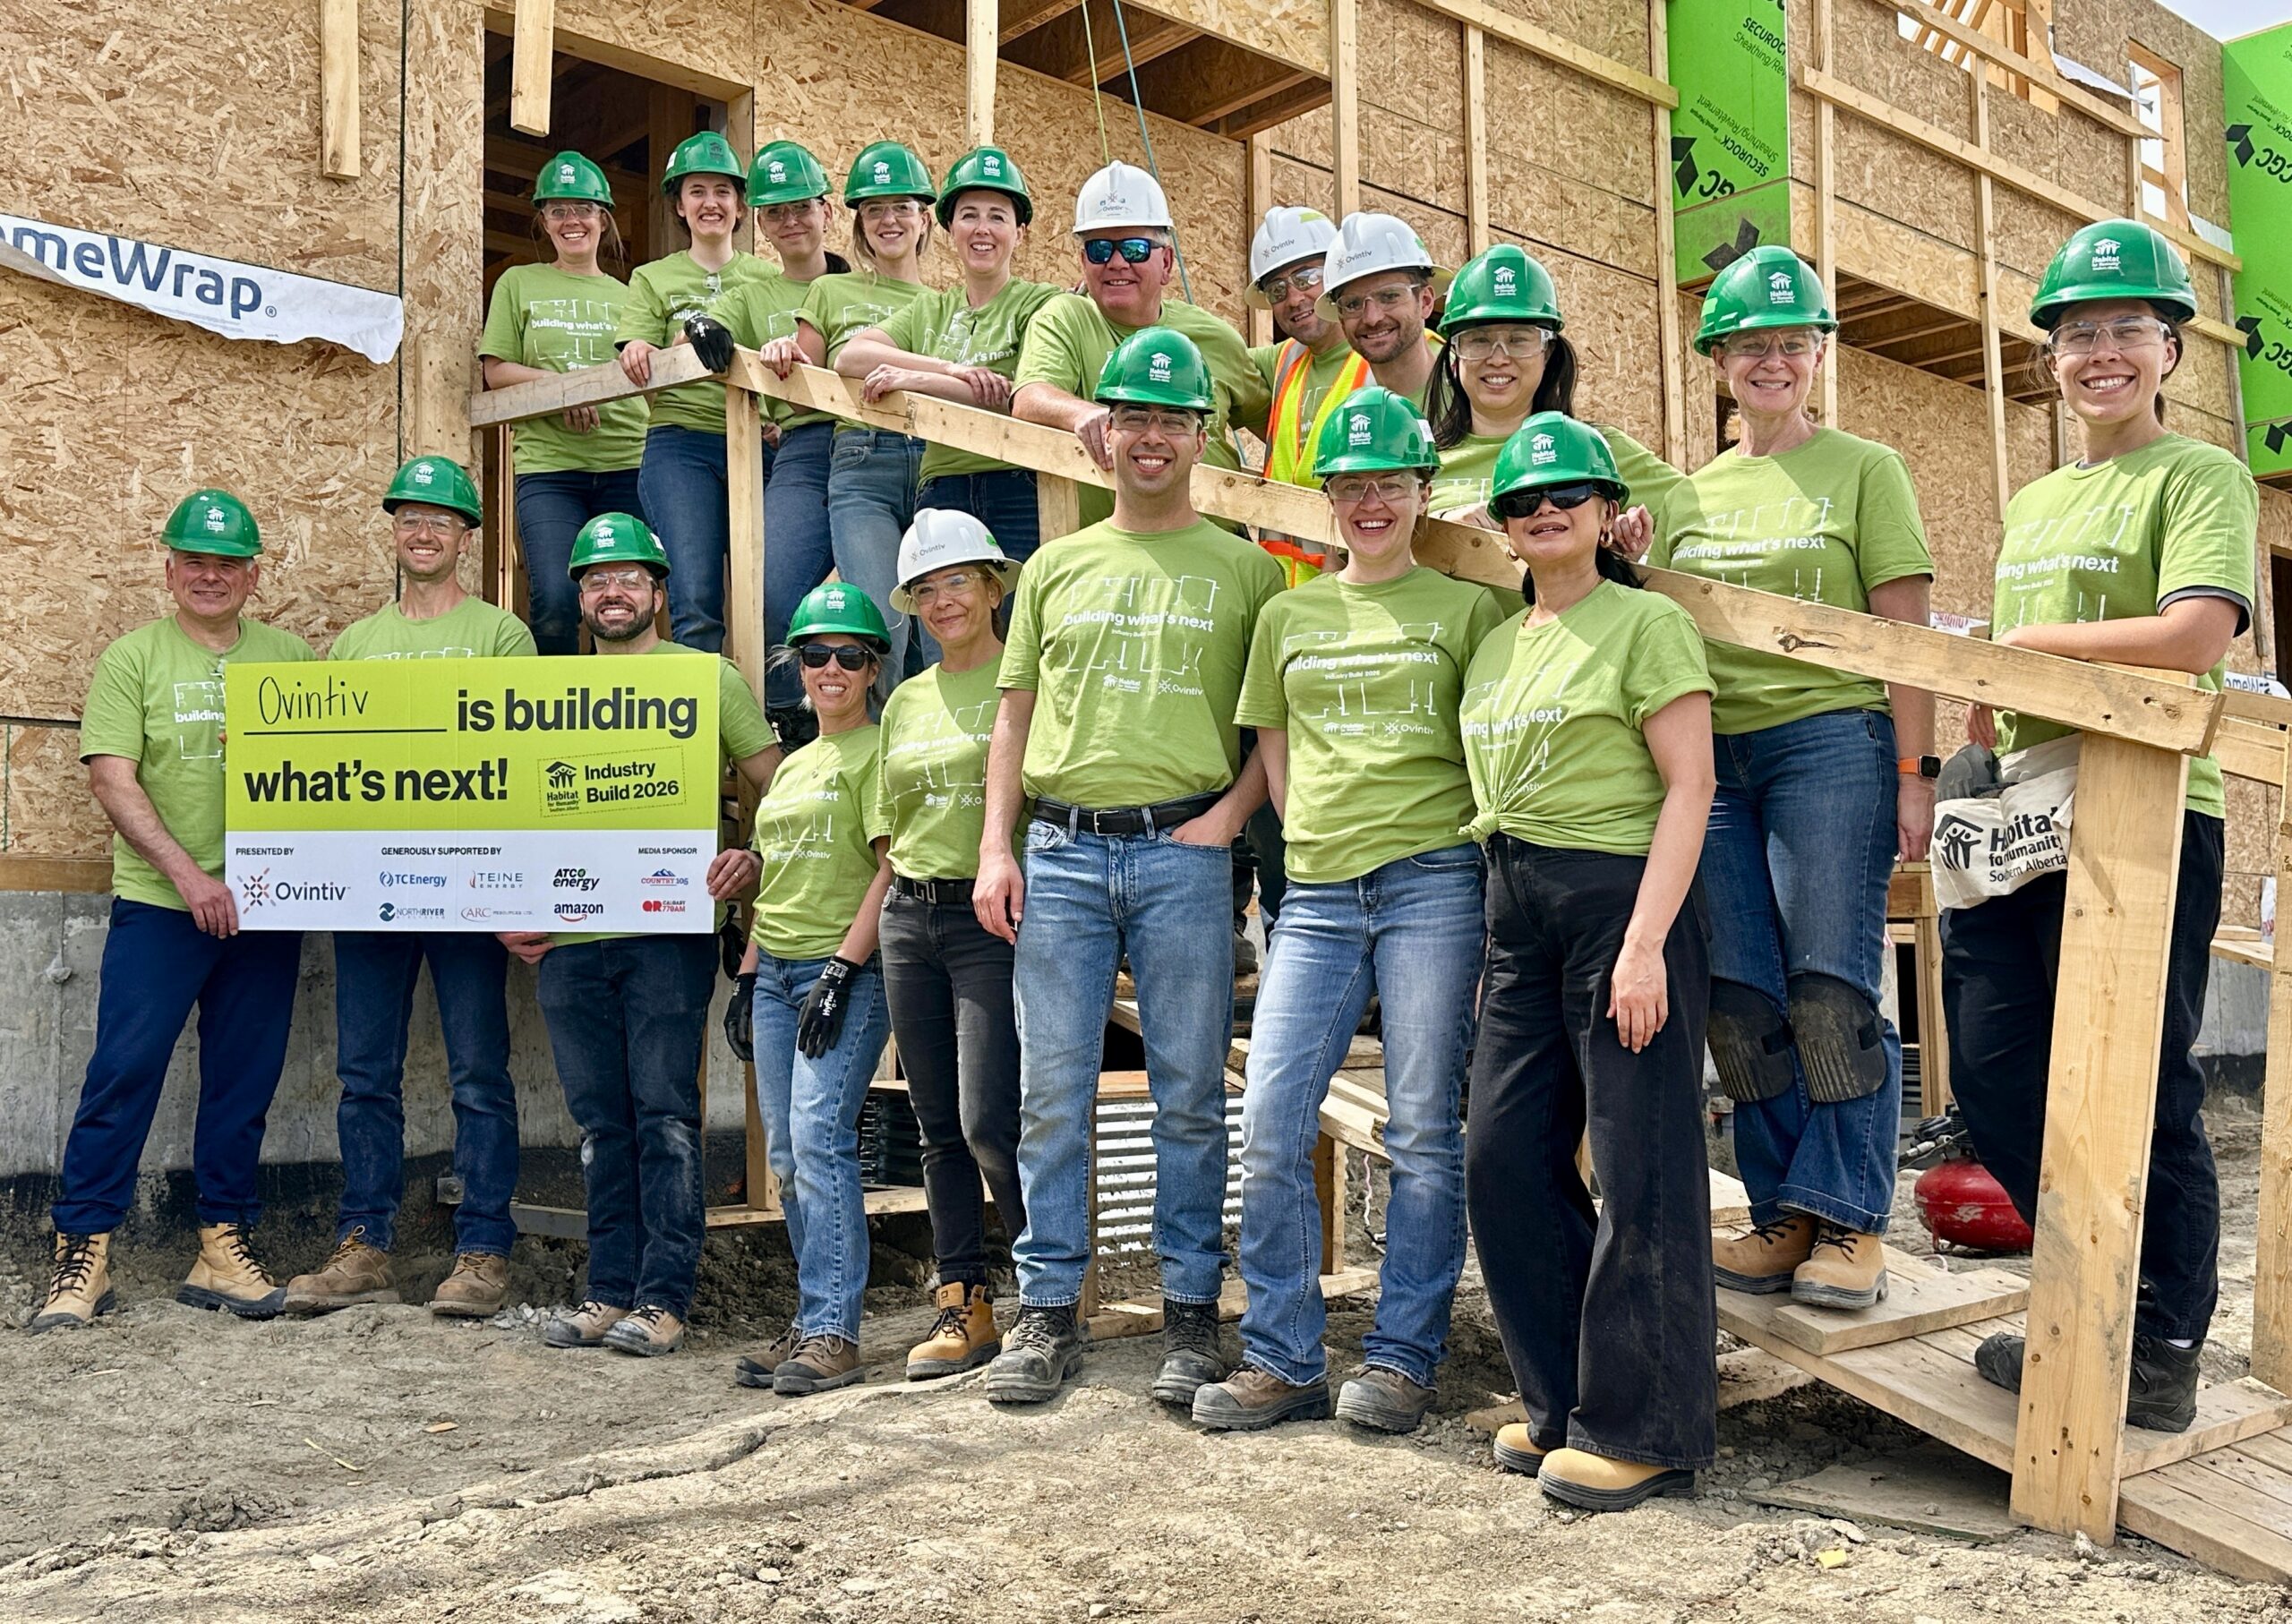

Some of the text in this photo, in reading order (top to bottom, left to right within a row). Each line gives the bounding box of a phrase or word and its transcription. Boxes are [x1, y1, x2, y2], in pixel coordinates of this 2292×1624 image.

[1720, 134, 1769, 177] SECUROCK
[1271, 239, 1295, 253] Ovintiv
[1346, 250, 1373, 263] Ovintiv
[919, 543, 945, 557] Ovintiv
[1725, 537, 1781, 556] what's
[1784, 535, 1826, 549] next
[2027, 553, 2070, 574] what's
[2072, 555, 2118, 573] next
[1064, 611, 1214, 633] building what's next
[1400, 651, 1439, 665] next
[1172, 684, 1203, 696] Ovintiv
[259, 675, 368, 724] Ovintiv
[175, 710, 226, 723] building
[458, 687, 697, 739] is building
[1400, 723, 1434, 735] Ovintiv
[585, 762, 655, 781] Industry
[244, 758, 508, 801] what's next!
[547, 791, 578, 801] Habitat
[586, 781, 680, 803] Build 2026
[235, 847, 295, 856] PRESENTED BY
[381, 847, 501, 856] GENEROUSLY SUPPORTED BY
[638, 847, 697, 855] MEDIA SPONSOR
[2026, 853, 2068, 872] Alberta
[477, 873, 523, 882] TEINE
[554, 868, 586, 878] ATCO
[552, 877, 600, 891] energy
[676, 877, 688, 885] 105
[276, 882, 346, 901] Ovintiv
[396, 908, 445, 916] NORTHRIVER
[466, 908, 492, 918] ARC
[553, 902, 603, 914] amazon
[822, 988, 835, 1016] HyFlex
